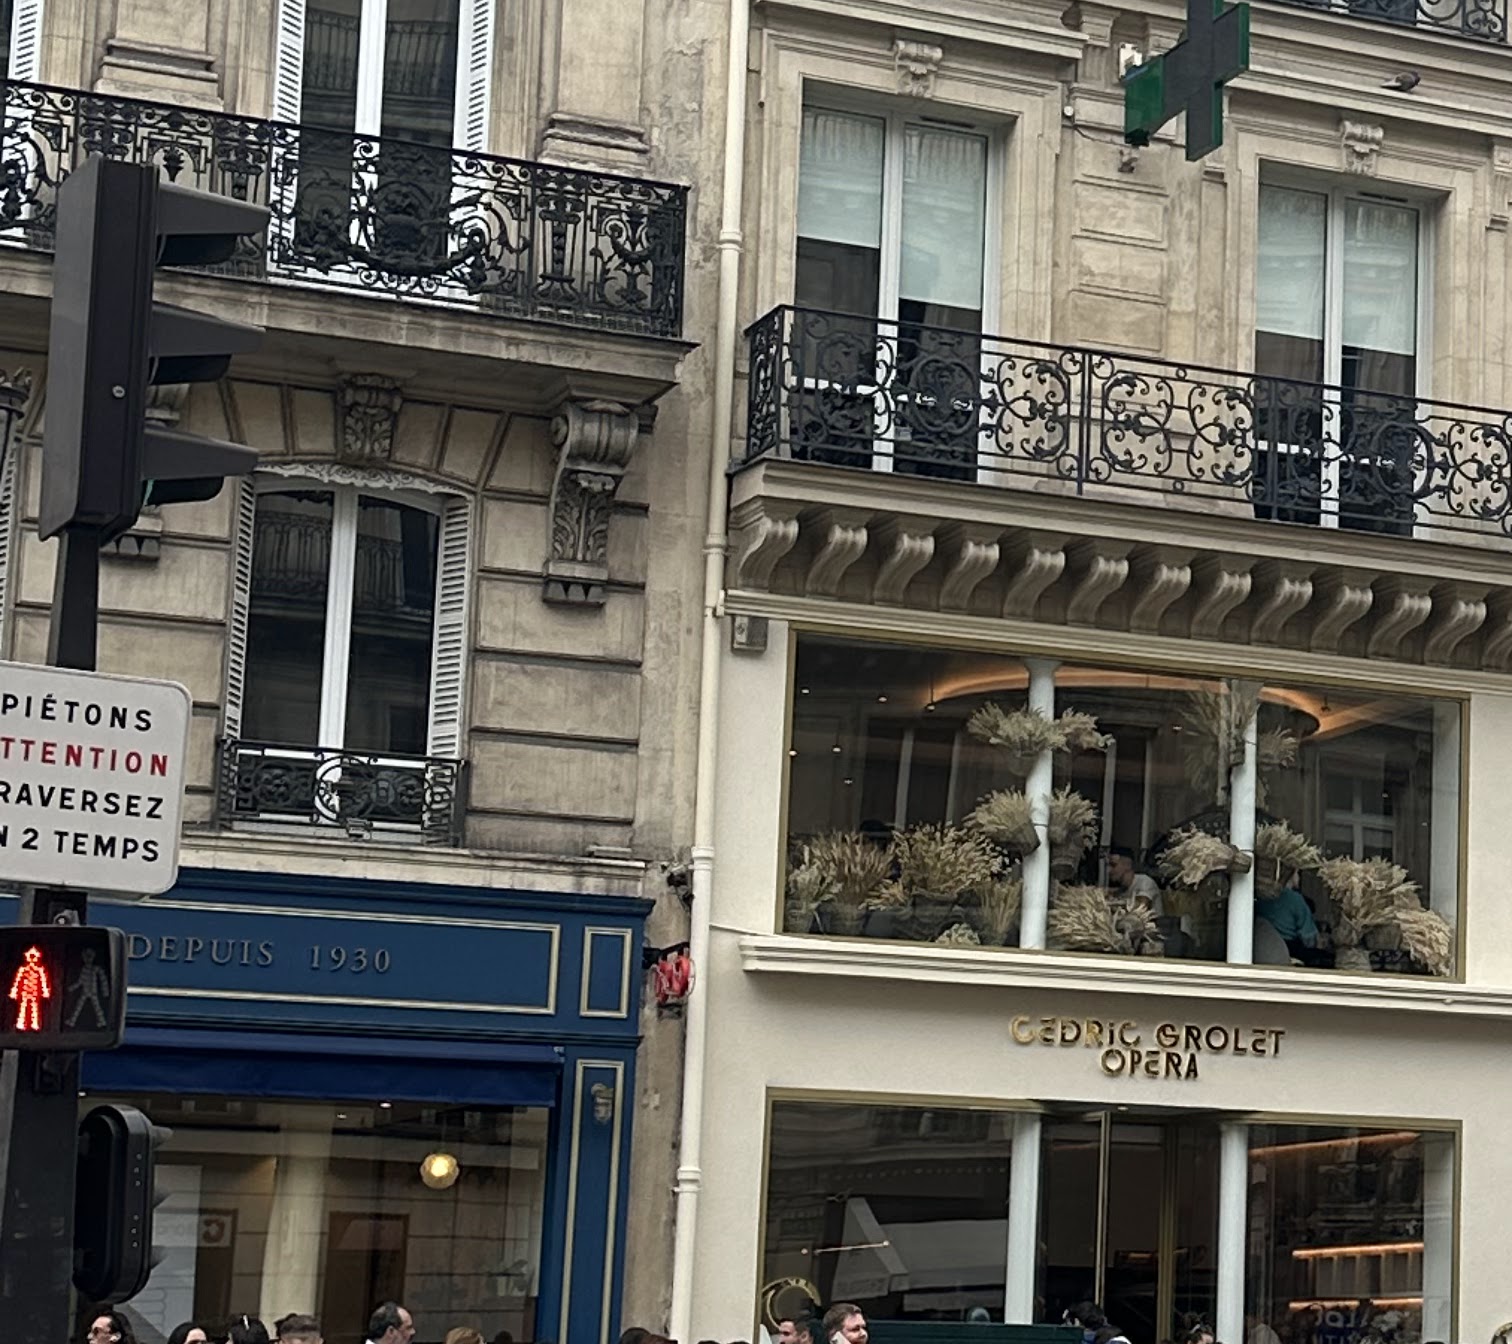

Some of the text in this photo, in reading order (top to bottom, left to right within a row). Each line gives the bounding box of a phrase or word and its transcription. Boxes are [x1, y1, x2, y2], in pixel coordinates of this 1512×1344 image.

[2, 692, 152, 732] PIÉTONS
[22, 827, 39, 850] 2
[54, 830, 159, 862] TEMPS
[127, 934, 391, 973] DEPUIS 1930
[1156, 1022, 1286, 1057] GROLET
[1100, 1048, 1199, 1080] OPERA
